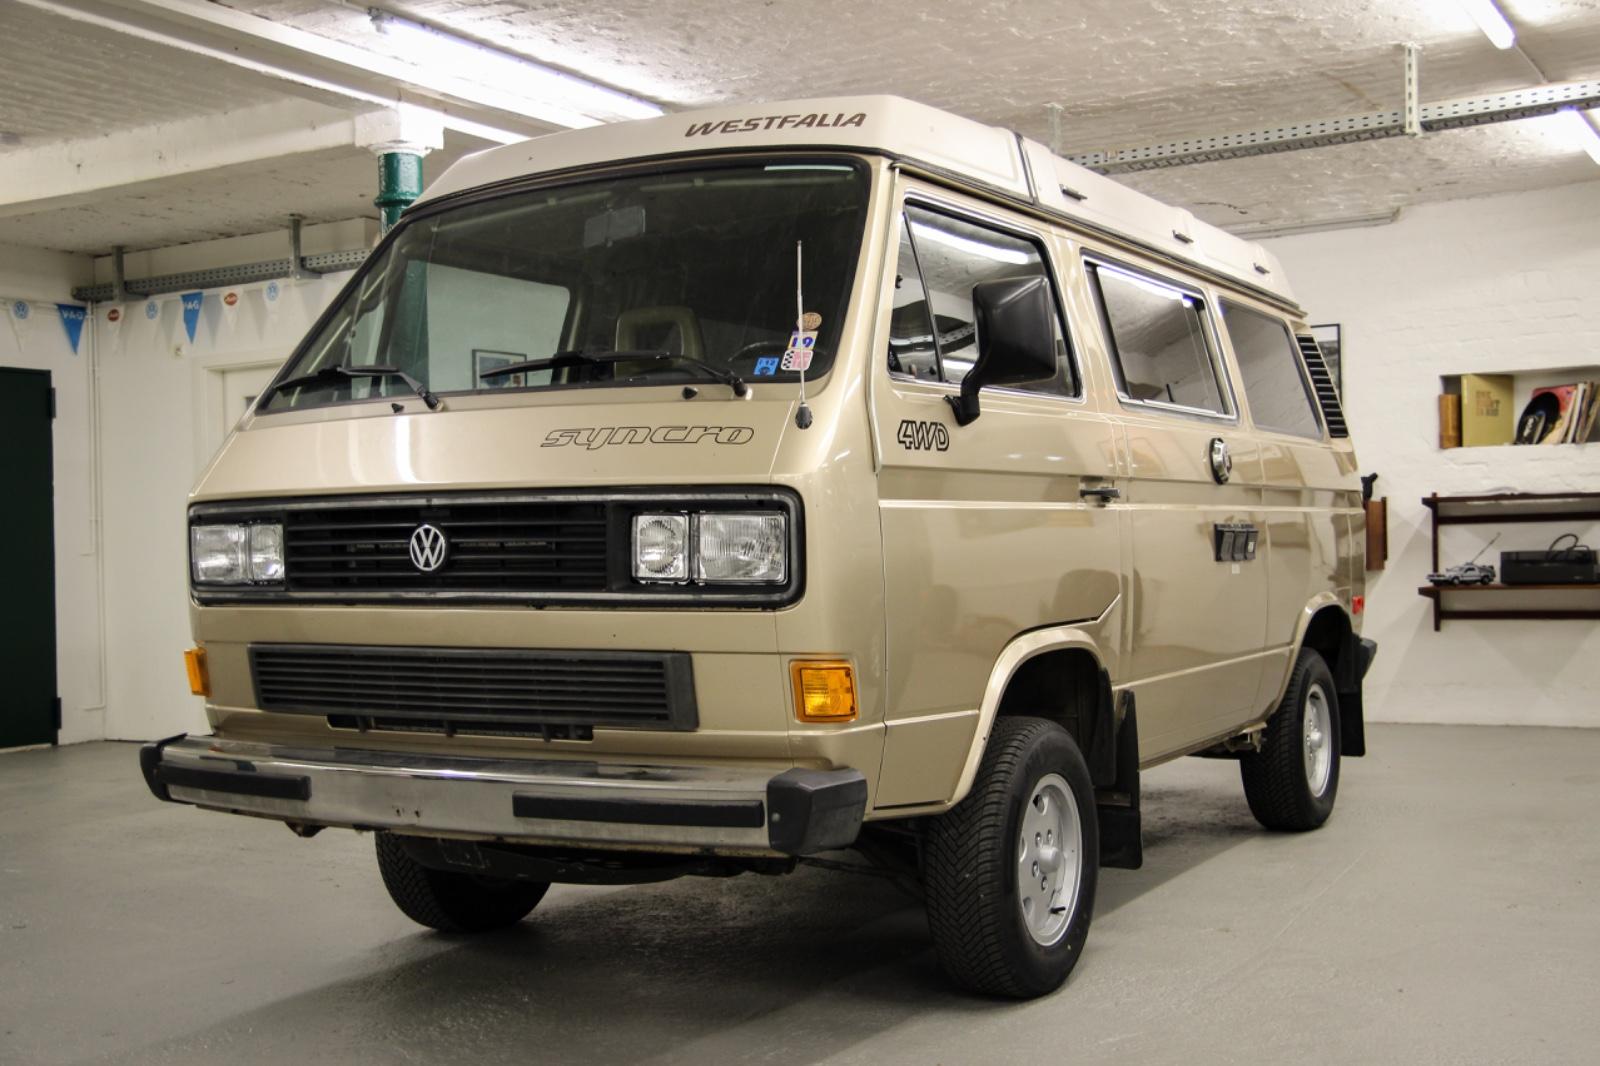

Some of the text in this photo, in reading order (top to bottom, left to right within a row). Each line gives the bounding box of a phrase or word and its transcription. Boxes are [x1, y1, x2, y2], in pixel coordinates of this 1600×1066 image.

[685, 112, 867, 138] WESTFALIA
[62, 310, 84, 320] VAG
[183, 300, 199, 310] AG
[540, 425, 755, 450] syncro
[897, 419, 950, 452] 4WD
[410, 523, 445, 571] VW
